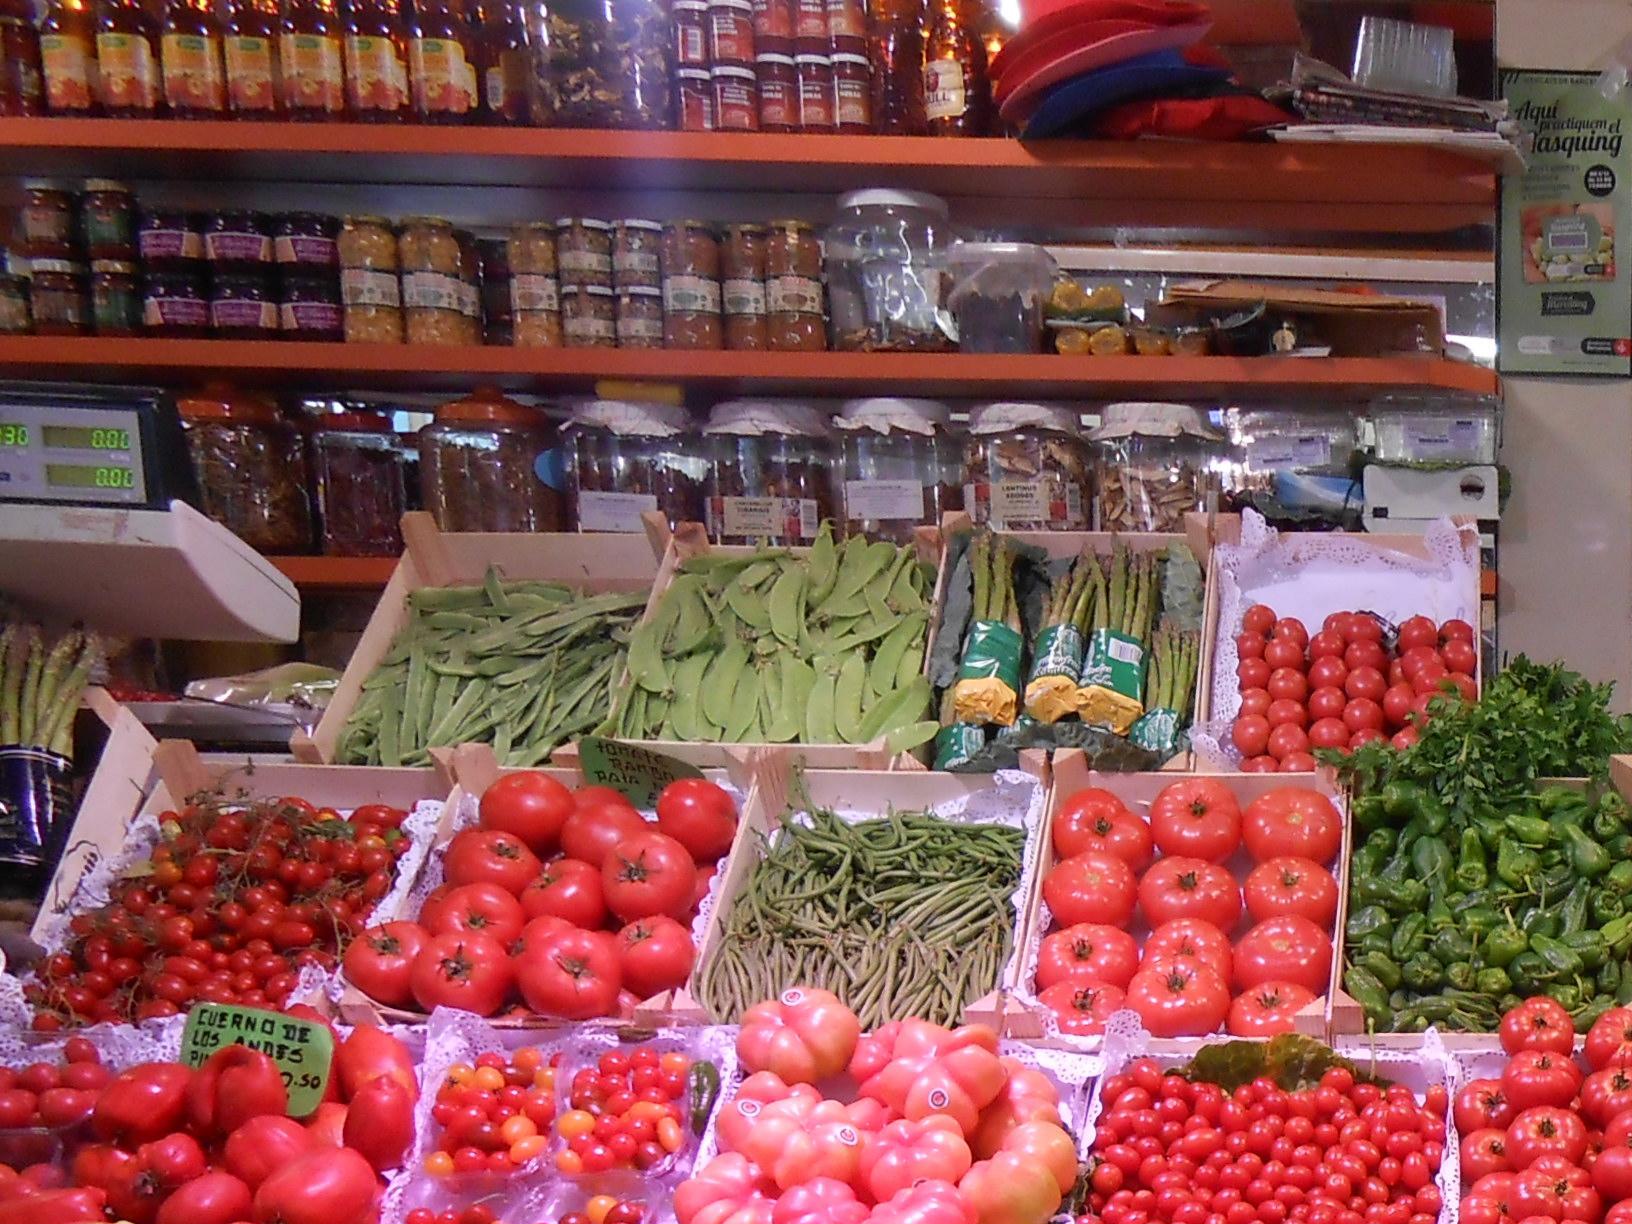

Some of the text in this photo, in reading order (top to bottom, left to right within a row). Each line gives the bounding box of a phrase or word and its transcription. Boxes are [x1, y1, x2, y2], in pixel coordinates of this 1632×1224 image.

[192, 1030, 221, 1048] LOS
[197, 1008, 312, 1044] CUERNO DE
